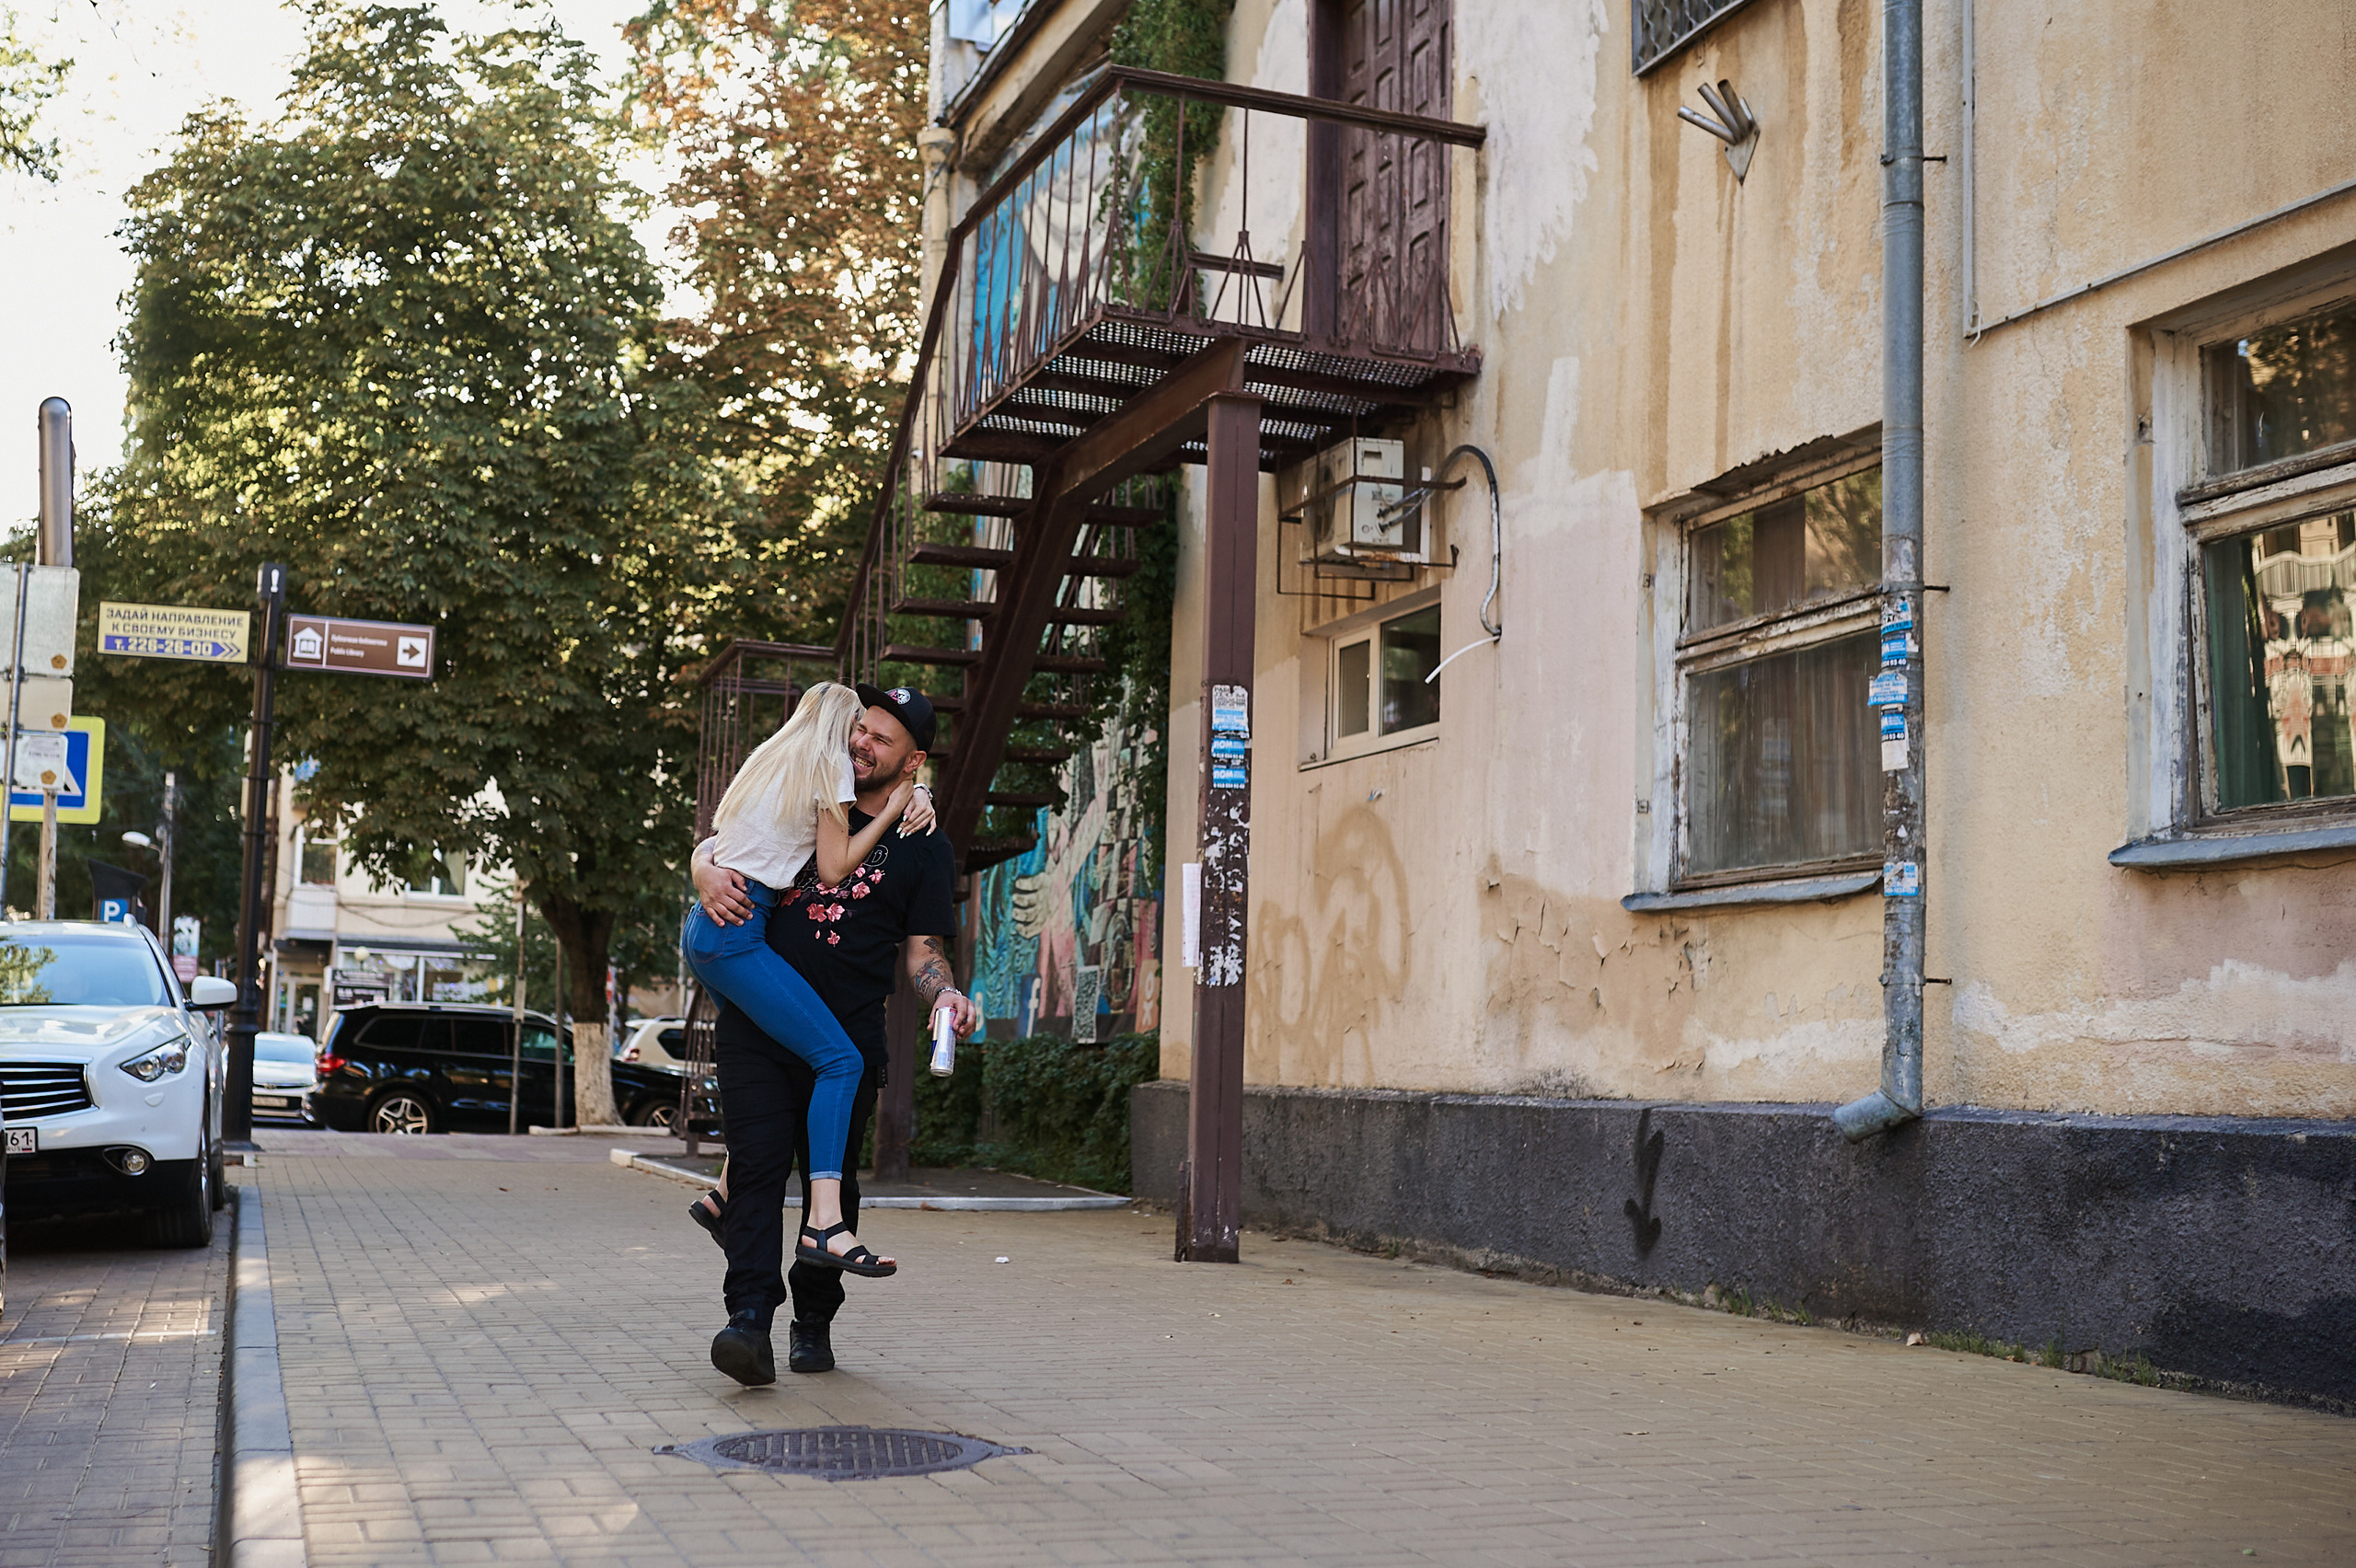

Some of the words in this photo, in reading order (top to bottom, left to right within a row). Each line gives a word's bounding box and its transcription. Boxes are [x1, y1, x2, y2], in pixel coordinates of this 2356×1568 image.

[106, 606, 148, 620] ЗАДАЙ
[152, 612, 244, 628] НАПРАВЛЕНИЕ
[111, 623, 119, 632] К
[122, 623, 175, 636] СВОЕМУ
[178, 628, 237, 640] БИЗНЕСУ
[104, 901, 121, 923] P
